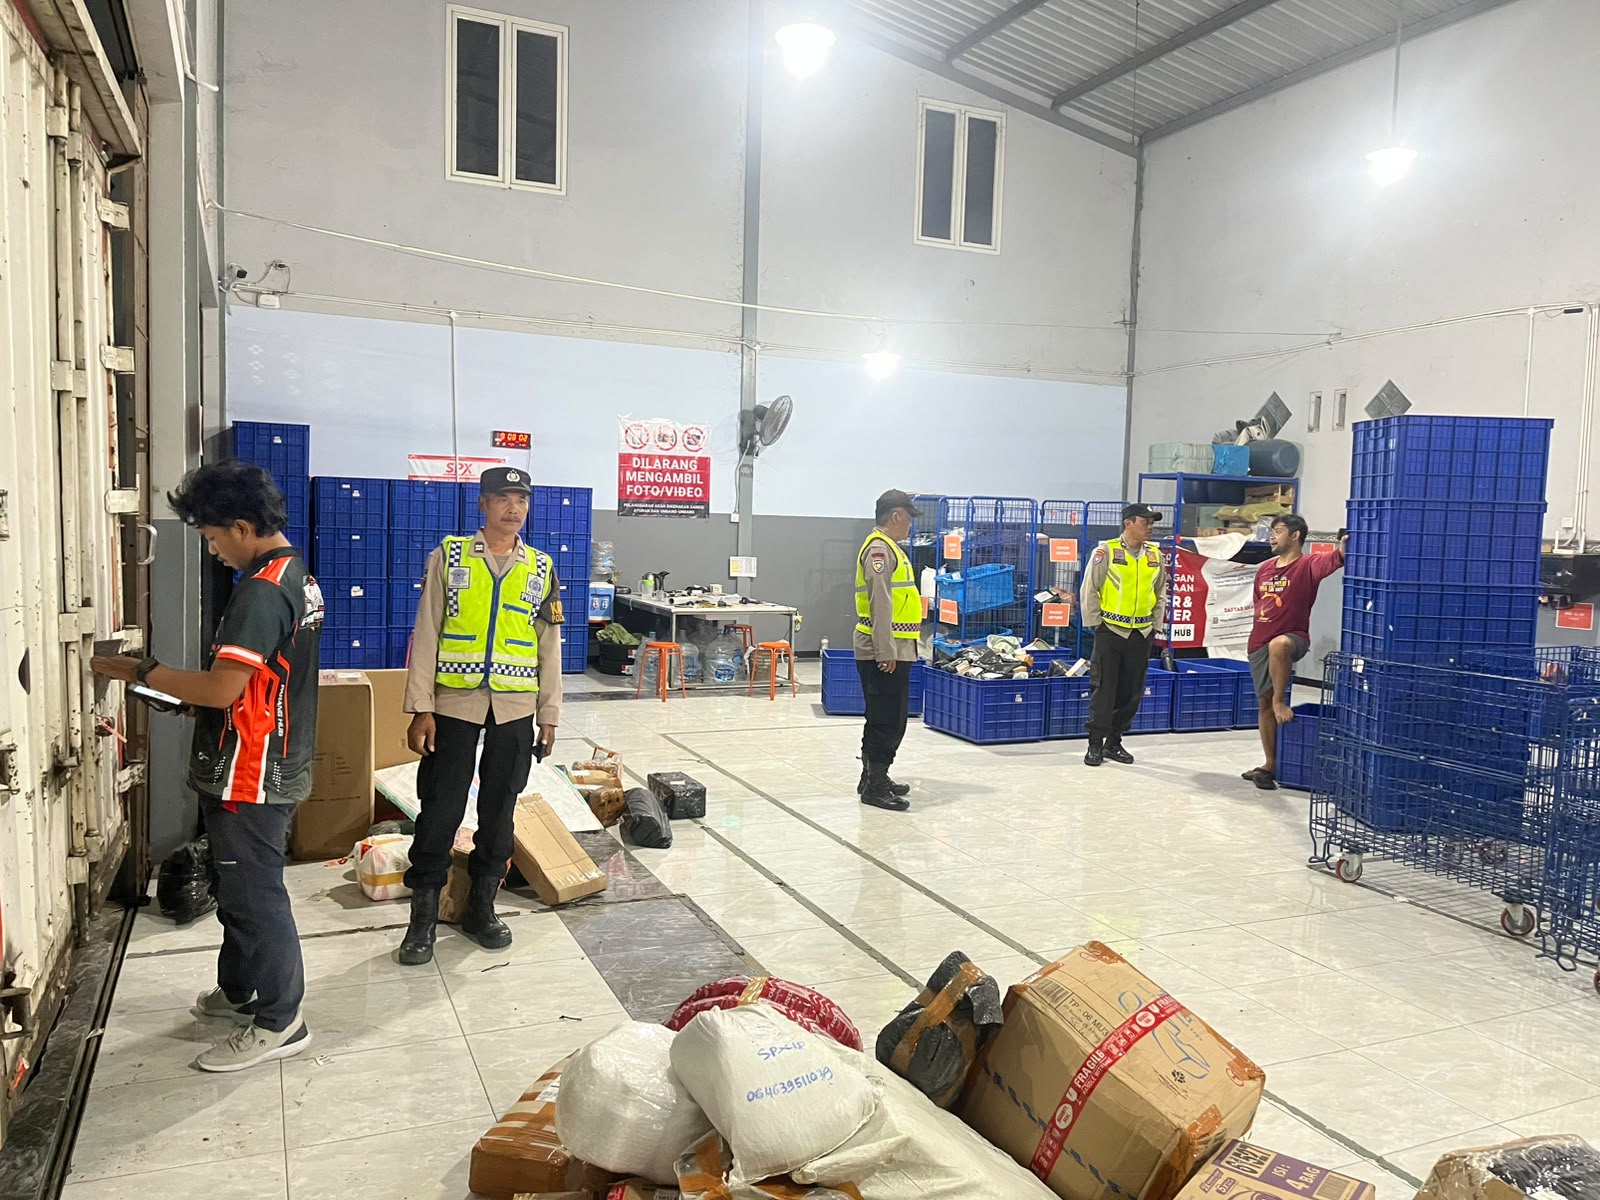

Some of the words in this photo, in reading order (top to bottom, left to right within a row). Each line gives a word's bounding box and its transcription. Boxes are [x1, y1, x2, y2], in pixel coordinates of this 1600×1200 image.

[445, 462, 473, 475] SPX
[632, 457, 698, 470] DILARANG
[625, 470, 704, 484] MENGAMBIL
[626, 484, 703, 498] FOTO/VIDEO
[1174, 629, 1192, 637] HUB
[1073, 1049, 1105, 1089] FRAGILE
[1299, 1166, 1321, 1184] BAG
